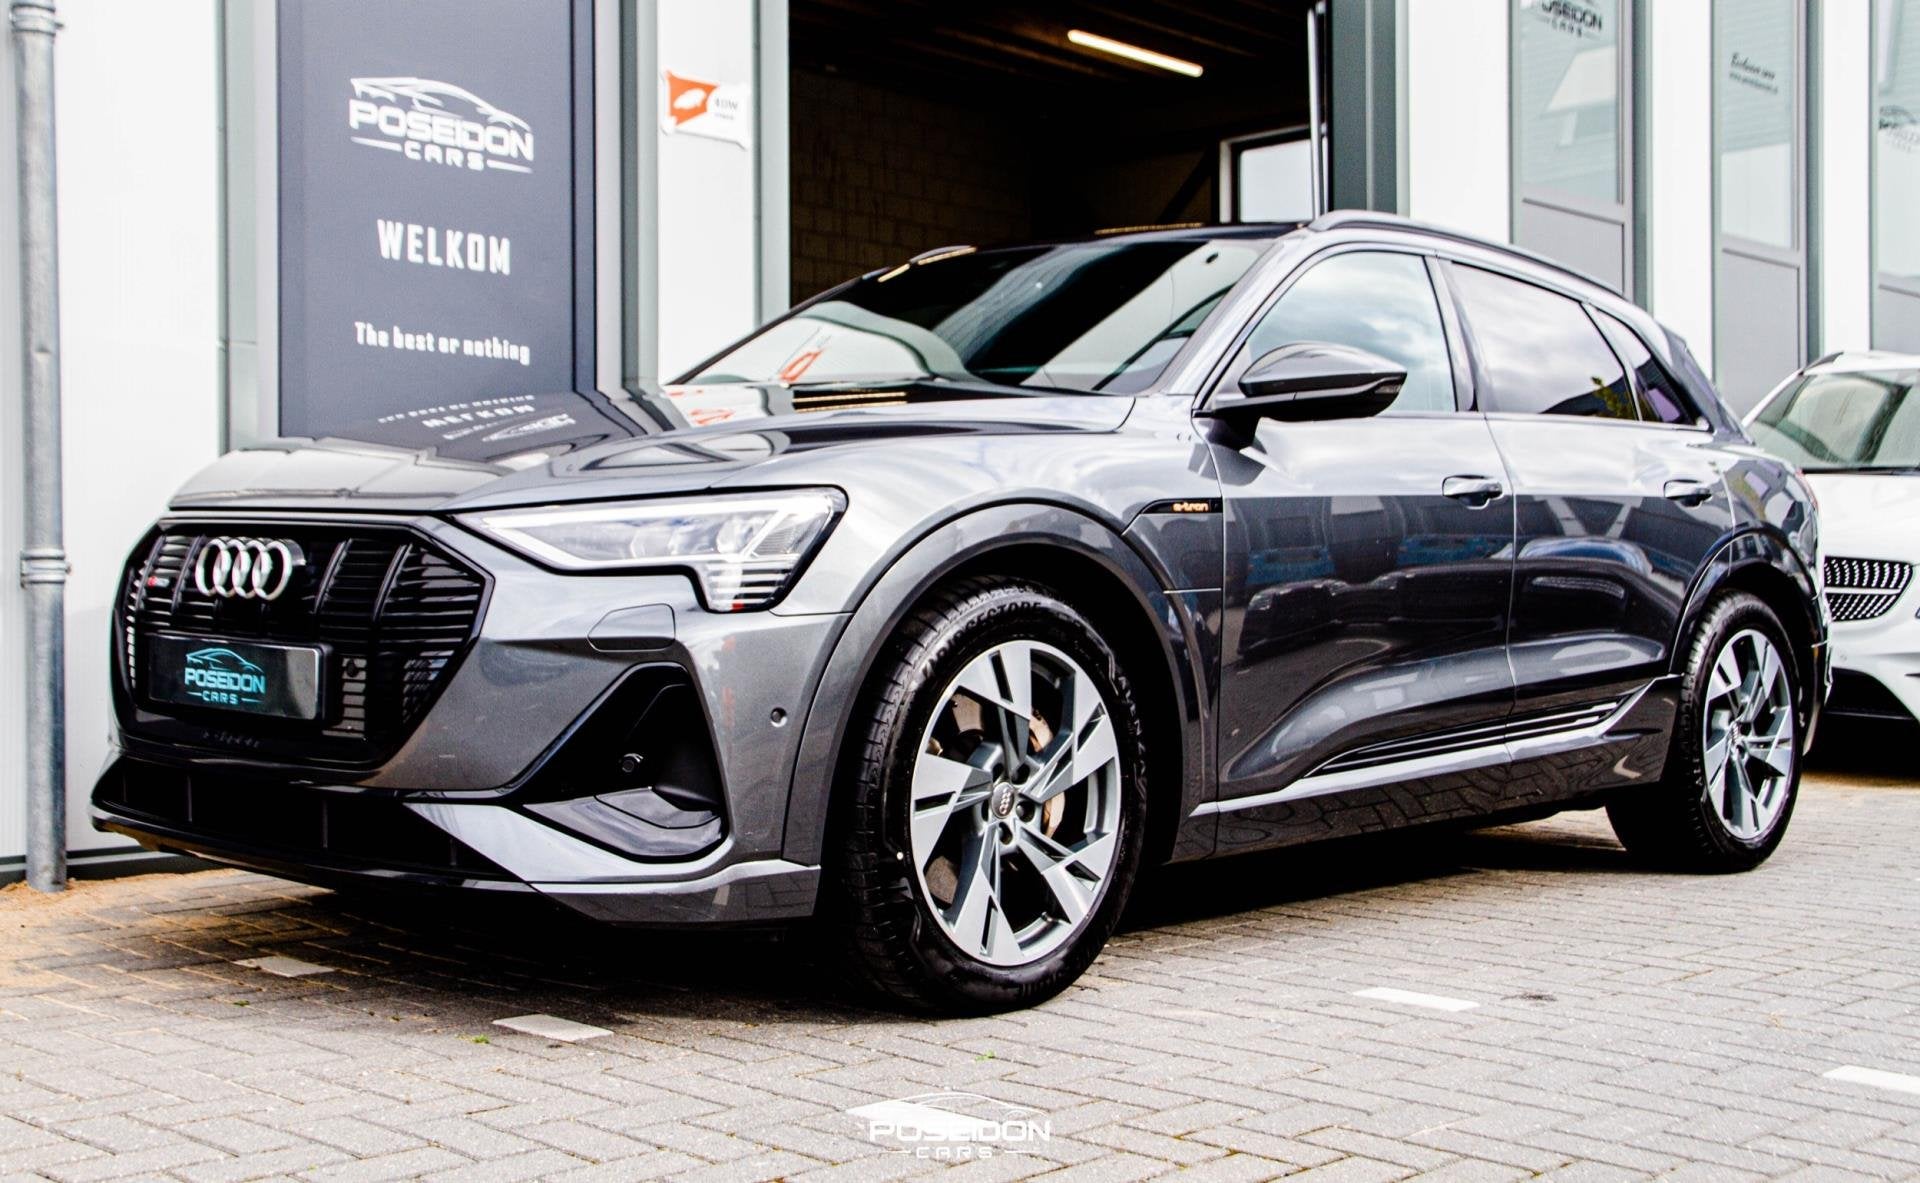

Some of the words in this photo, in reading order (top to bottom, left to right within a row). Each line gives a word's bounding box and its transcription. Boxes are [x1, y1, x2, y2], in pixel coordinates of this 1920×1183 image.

[1541, 0, 1602, 30] OSEIDON
[349, 99, 534, 161] POSEIDON
[404, 140, 485, 171] CARS
[376, 219, 511, 276] WELKOM
[354, 321, 390, 347] The
[393, 325, 435, 352] best
[438, 336, 460, 354] or
[463, 336, 531, 366] nothing
[184, 667, 266, 694] POSEIDON
[202, 690, 239, 705] CARS
